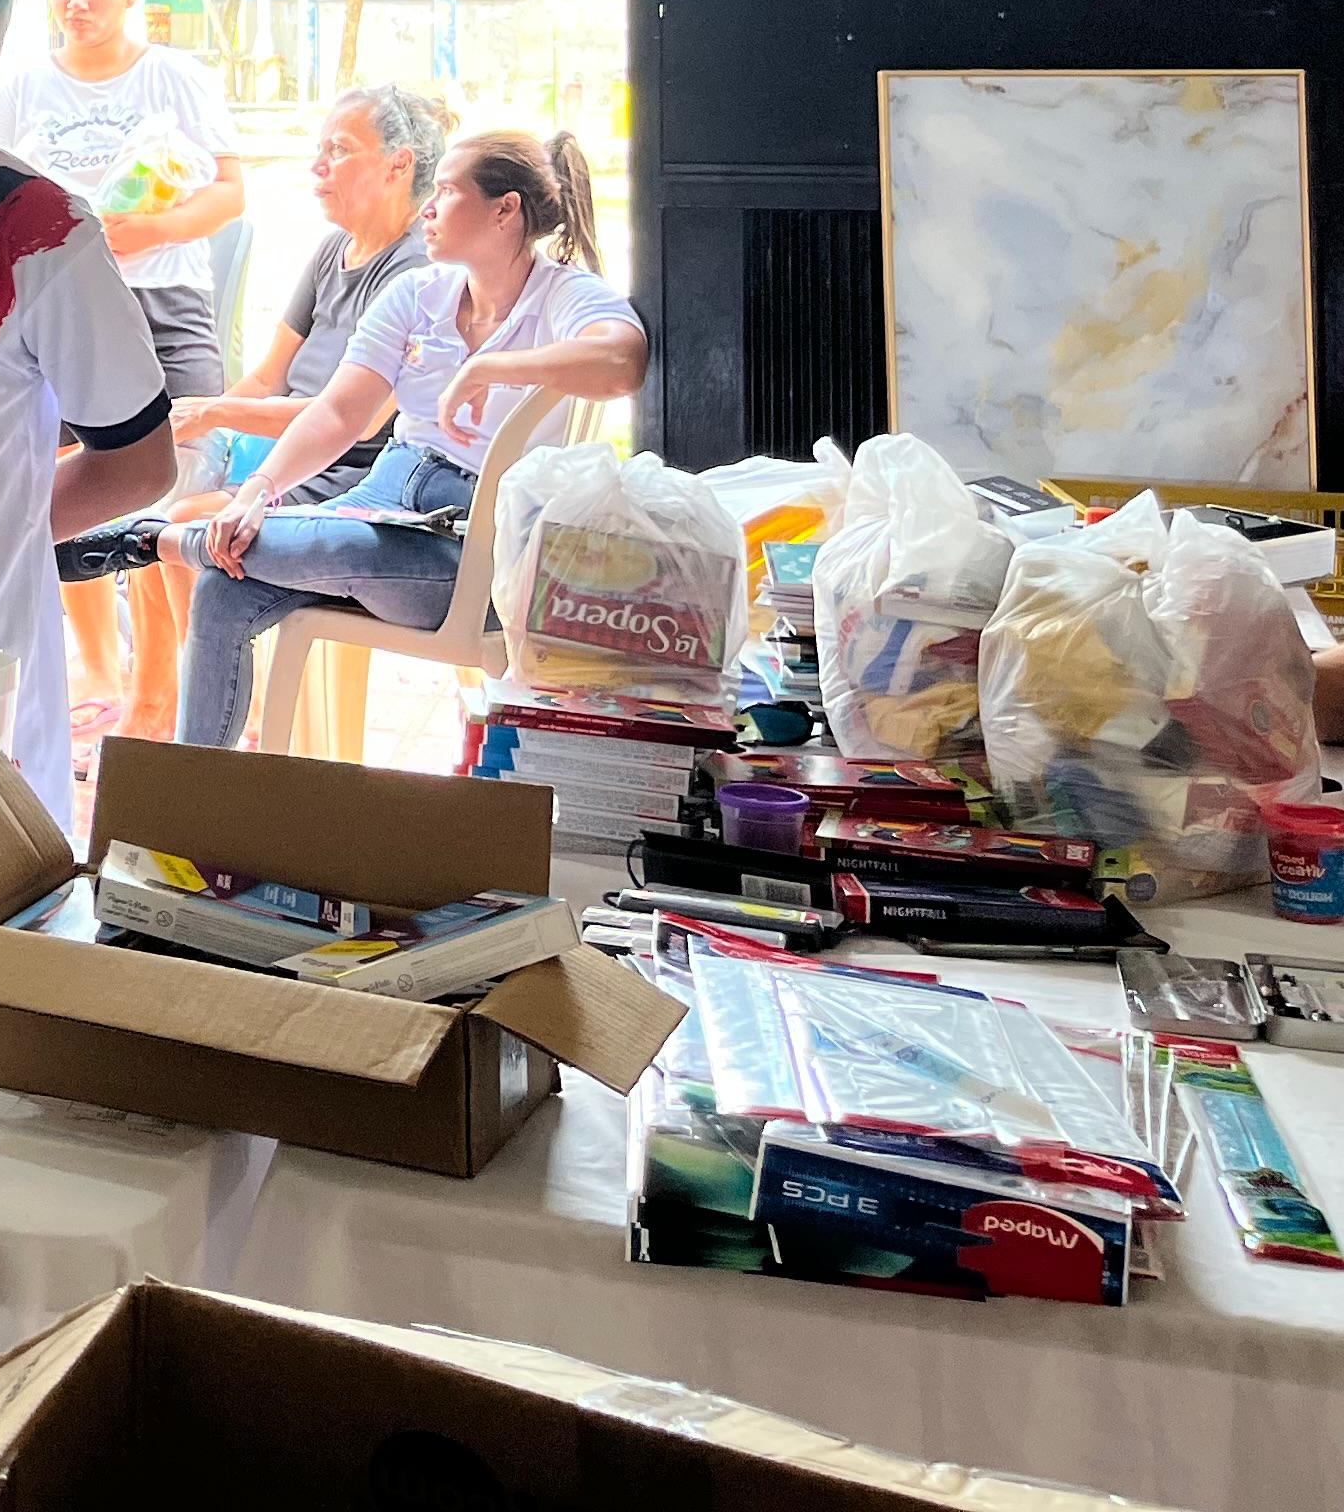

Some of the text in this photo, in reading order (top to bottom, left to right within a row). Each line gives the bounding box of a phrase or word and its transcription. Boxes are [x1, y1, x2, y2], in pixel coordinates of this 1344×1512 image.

[551, 595, 679, 654] Sopera
[836, 857, 900, 873] NIGHTFALL
[883, 905, 947, 920] NIGHTFALL
[781, 1179, 880, 1216] 3 PCS
[983, 1215, 1079, 1249] Maped
